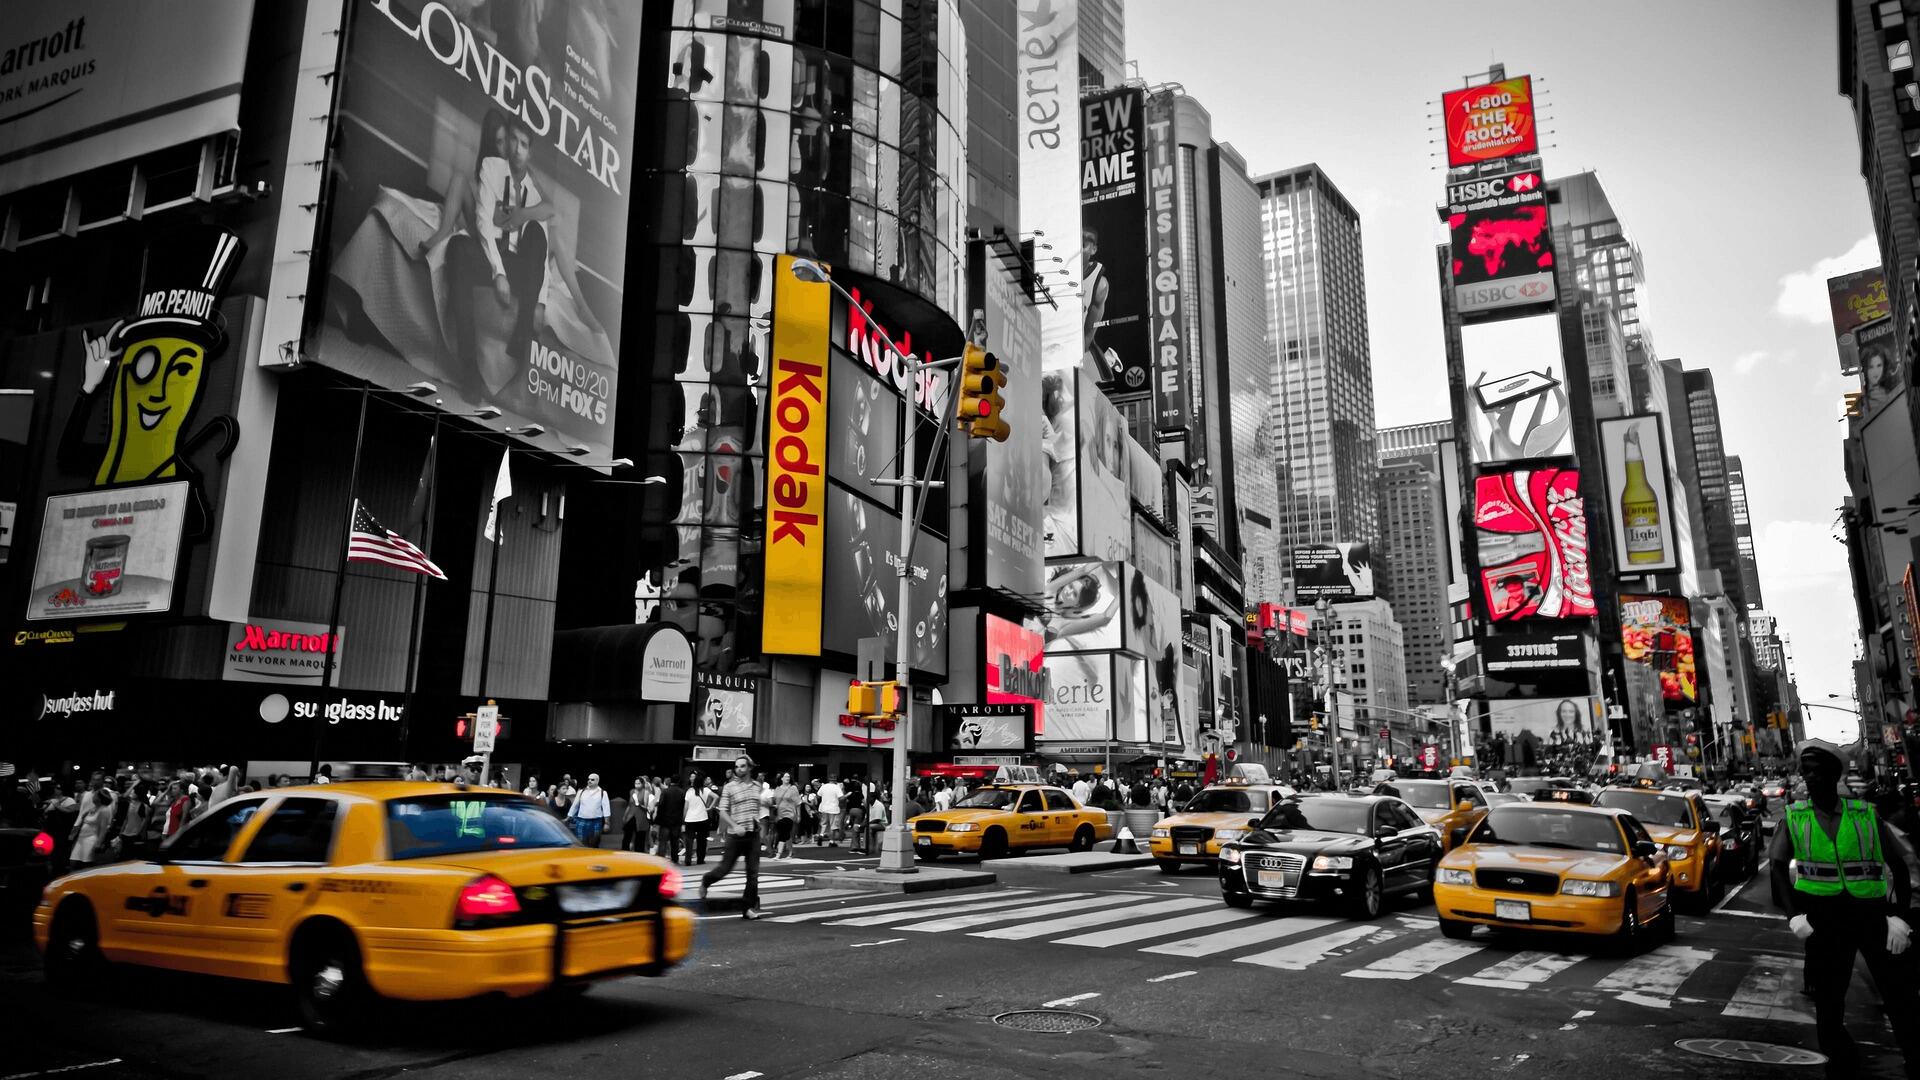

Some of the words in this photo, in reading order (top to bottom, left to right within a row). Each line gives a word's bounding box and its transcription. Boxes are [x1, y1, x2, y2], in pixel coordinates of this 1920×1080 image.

[0, 16, 85, 76] arriott
[566, 45, 580, 64] One
[28, 59, 96, 95] MARQUIS
[565, 62, 580, 82] Two
[564, 80, 577, 100] The
[1025, 34, 1061, 150] aerie
[1462, 92, 1512, 114] 1-800
[1085, 94, 1133, 138] EW
[1470, 108, 1507, 128] THE
[1081, 128, 1135, 161] ORK'S
[1464, 121, 1517, 144] ROCK
[1082, 150, 1136, 190] AME
[1150, 120, 1173, 234] TIMES
[1448, 178, 1505, 204] HSBC
[1520, 190, 1543, 203] bank
[140, 291, 165, 317] MR.
[165, 288, 216, 320] PEANUT
[1462, 284, 1517, 306] HSBC
[1154, 246, 1180, 393] SQUARE
[530, 340, 574, 384] MON
[575, 364, 609, 400] 9/20
[528, 368, 559, 405] 9PM
[560, 382, 594, 420] FOX
[594, 400, 607, 425] 5
[1162, 409, 1179, 418] NYC
[772, 358, 823, 548] Kodak
[1630, 528, 1659, 542] Light
[229, 654, 255, 664] NEW
[257, 655, 286, 667] YORK
[289, 659, 337, 670] MARQUS
[649, 657, 686, 670] Marriott
[697, 671, 755, 690] MARQUIS
[998, 652, 1034, 698] Bank
[45, 691, 93, 719] sunglass
[93, 689, 115, 711] hut
[378, 699, 404, 722] hu
[949, 705, 1027, 715] MARQUIS
